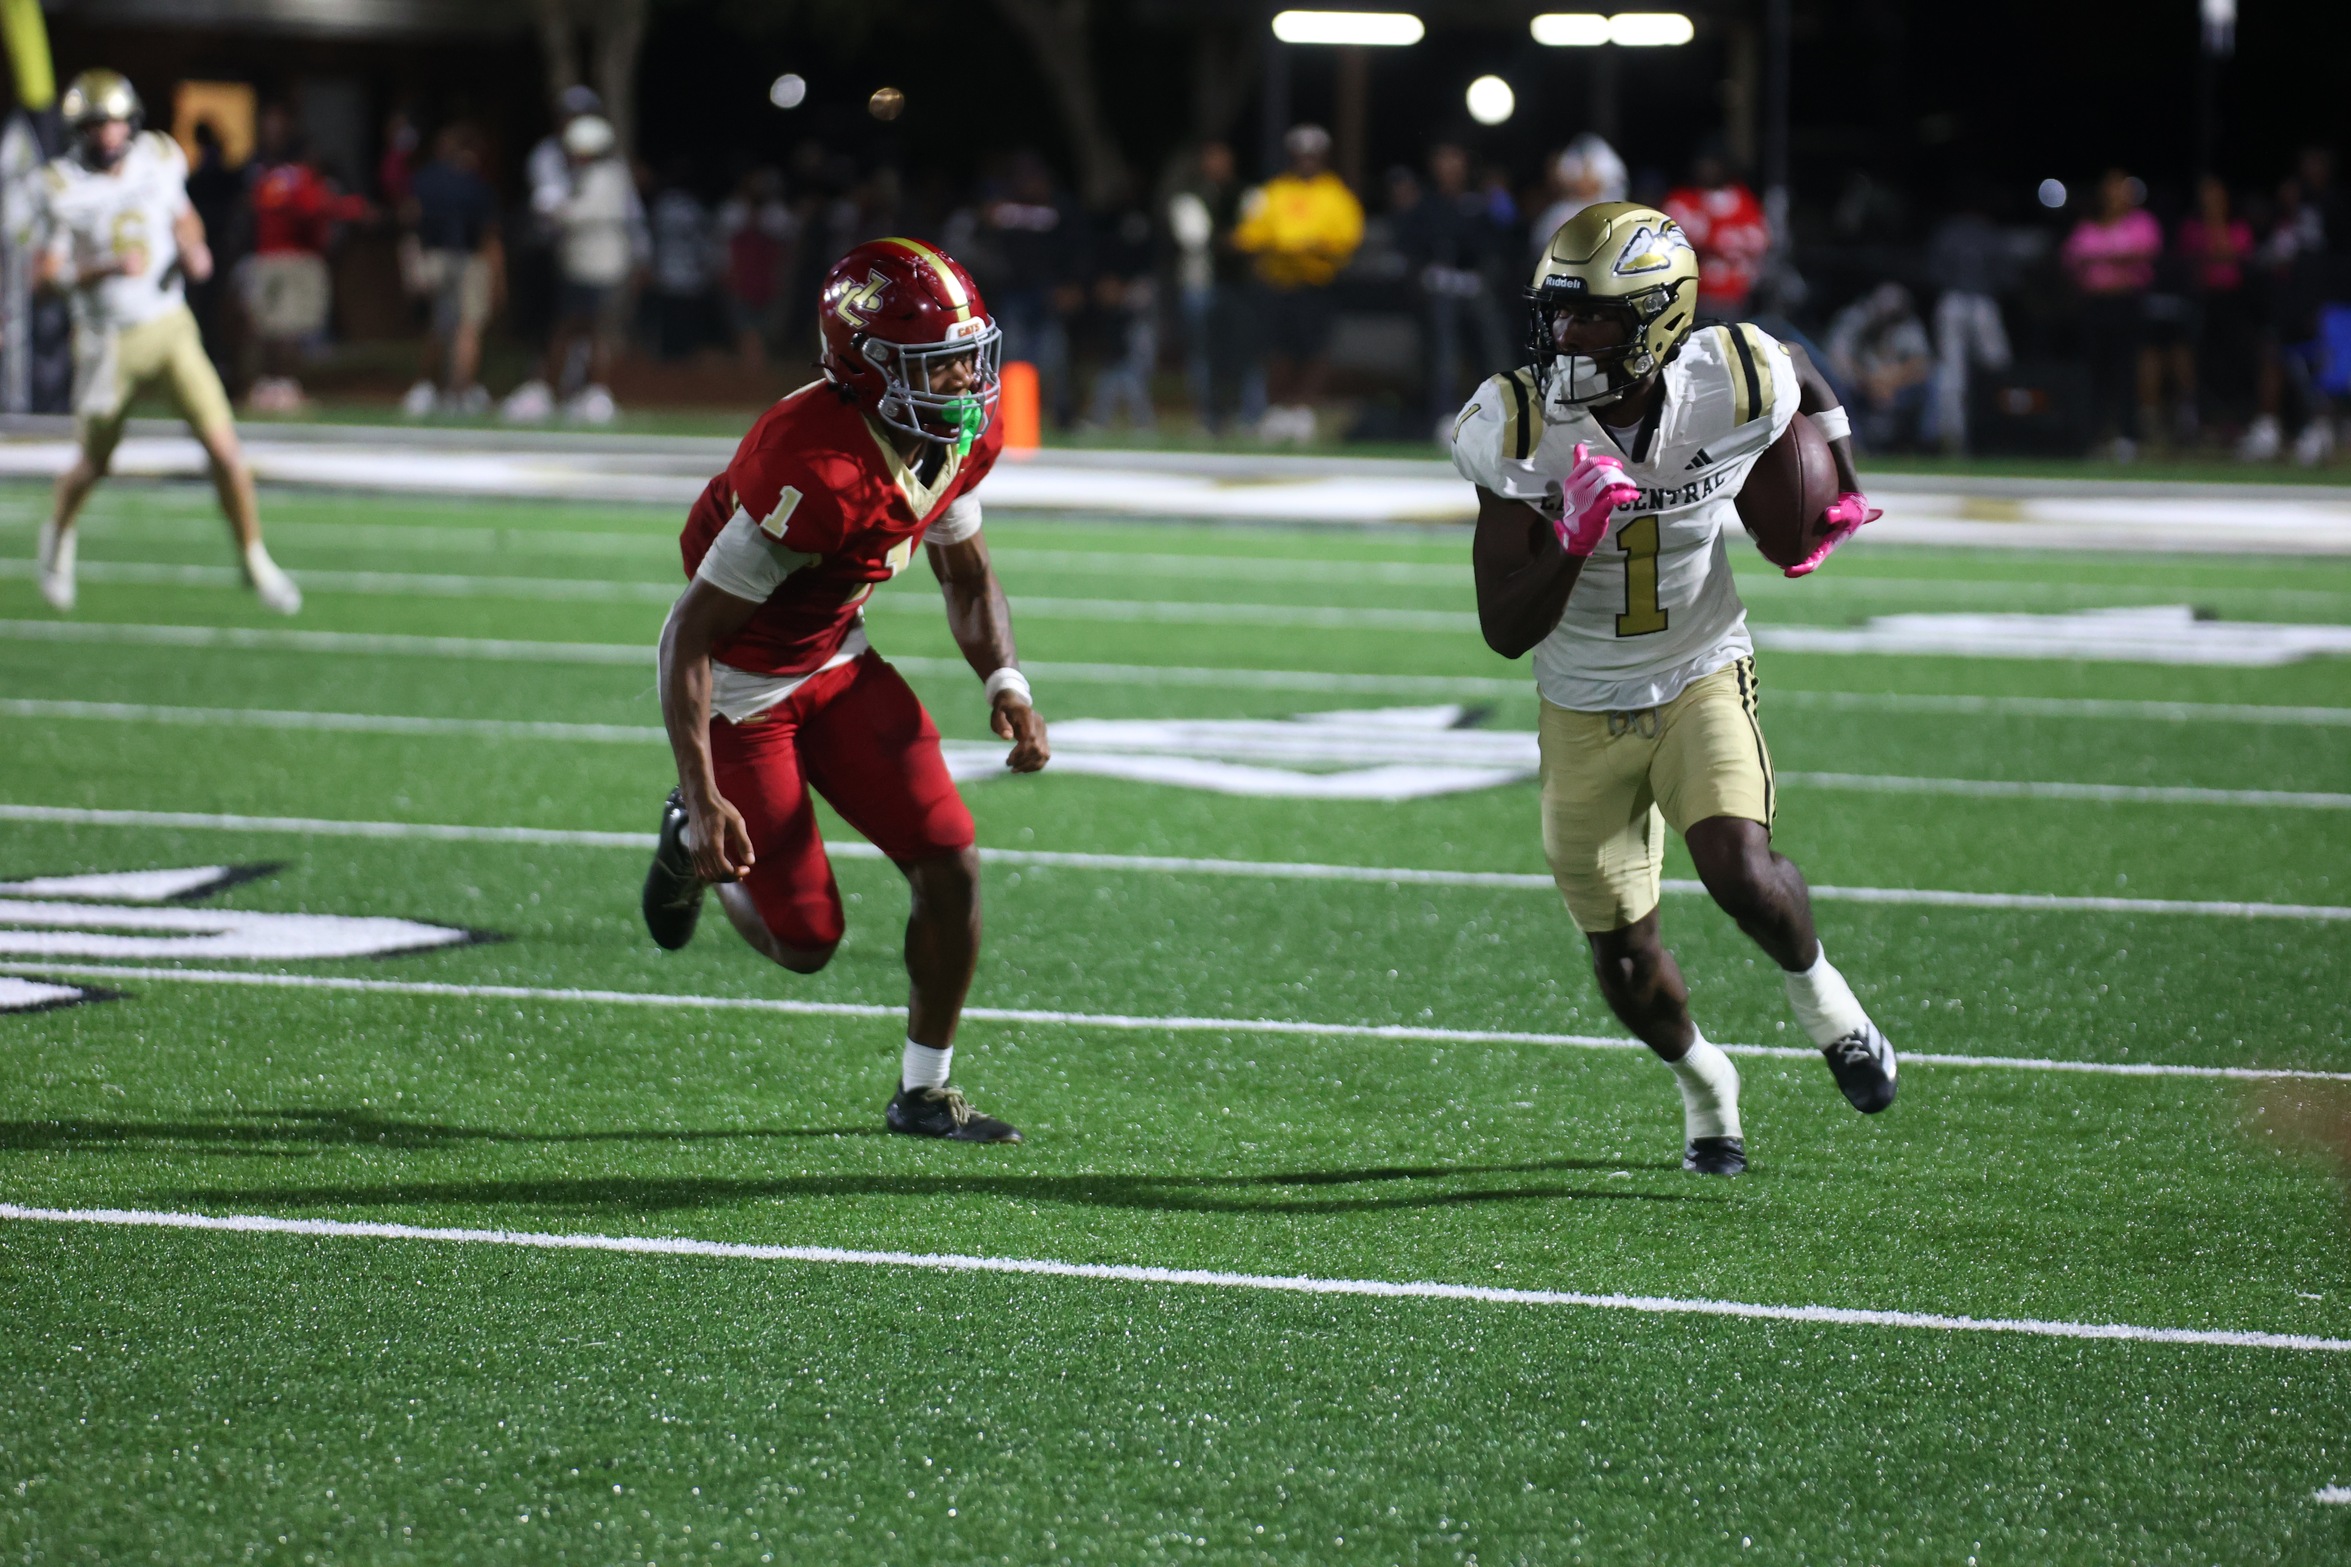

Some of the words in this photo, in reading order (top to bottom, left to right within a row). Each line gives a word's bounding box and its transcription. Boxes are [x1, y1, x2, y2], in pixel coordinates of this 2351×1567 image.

[1545, 276, 1581, 289] Riddell
[760, 485, 803, 539] 1
[1615, 514, 1669, 638] 1
